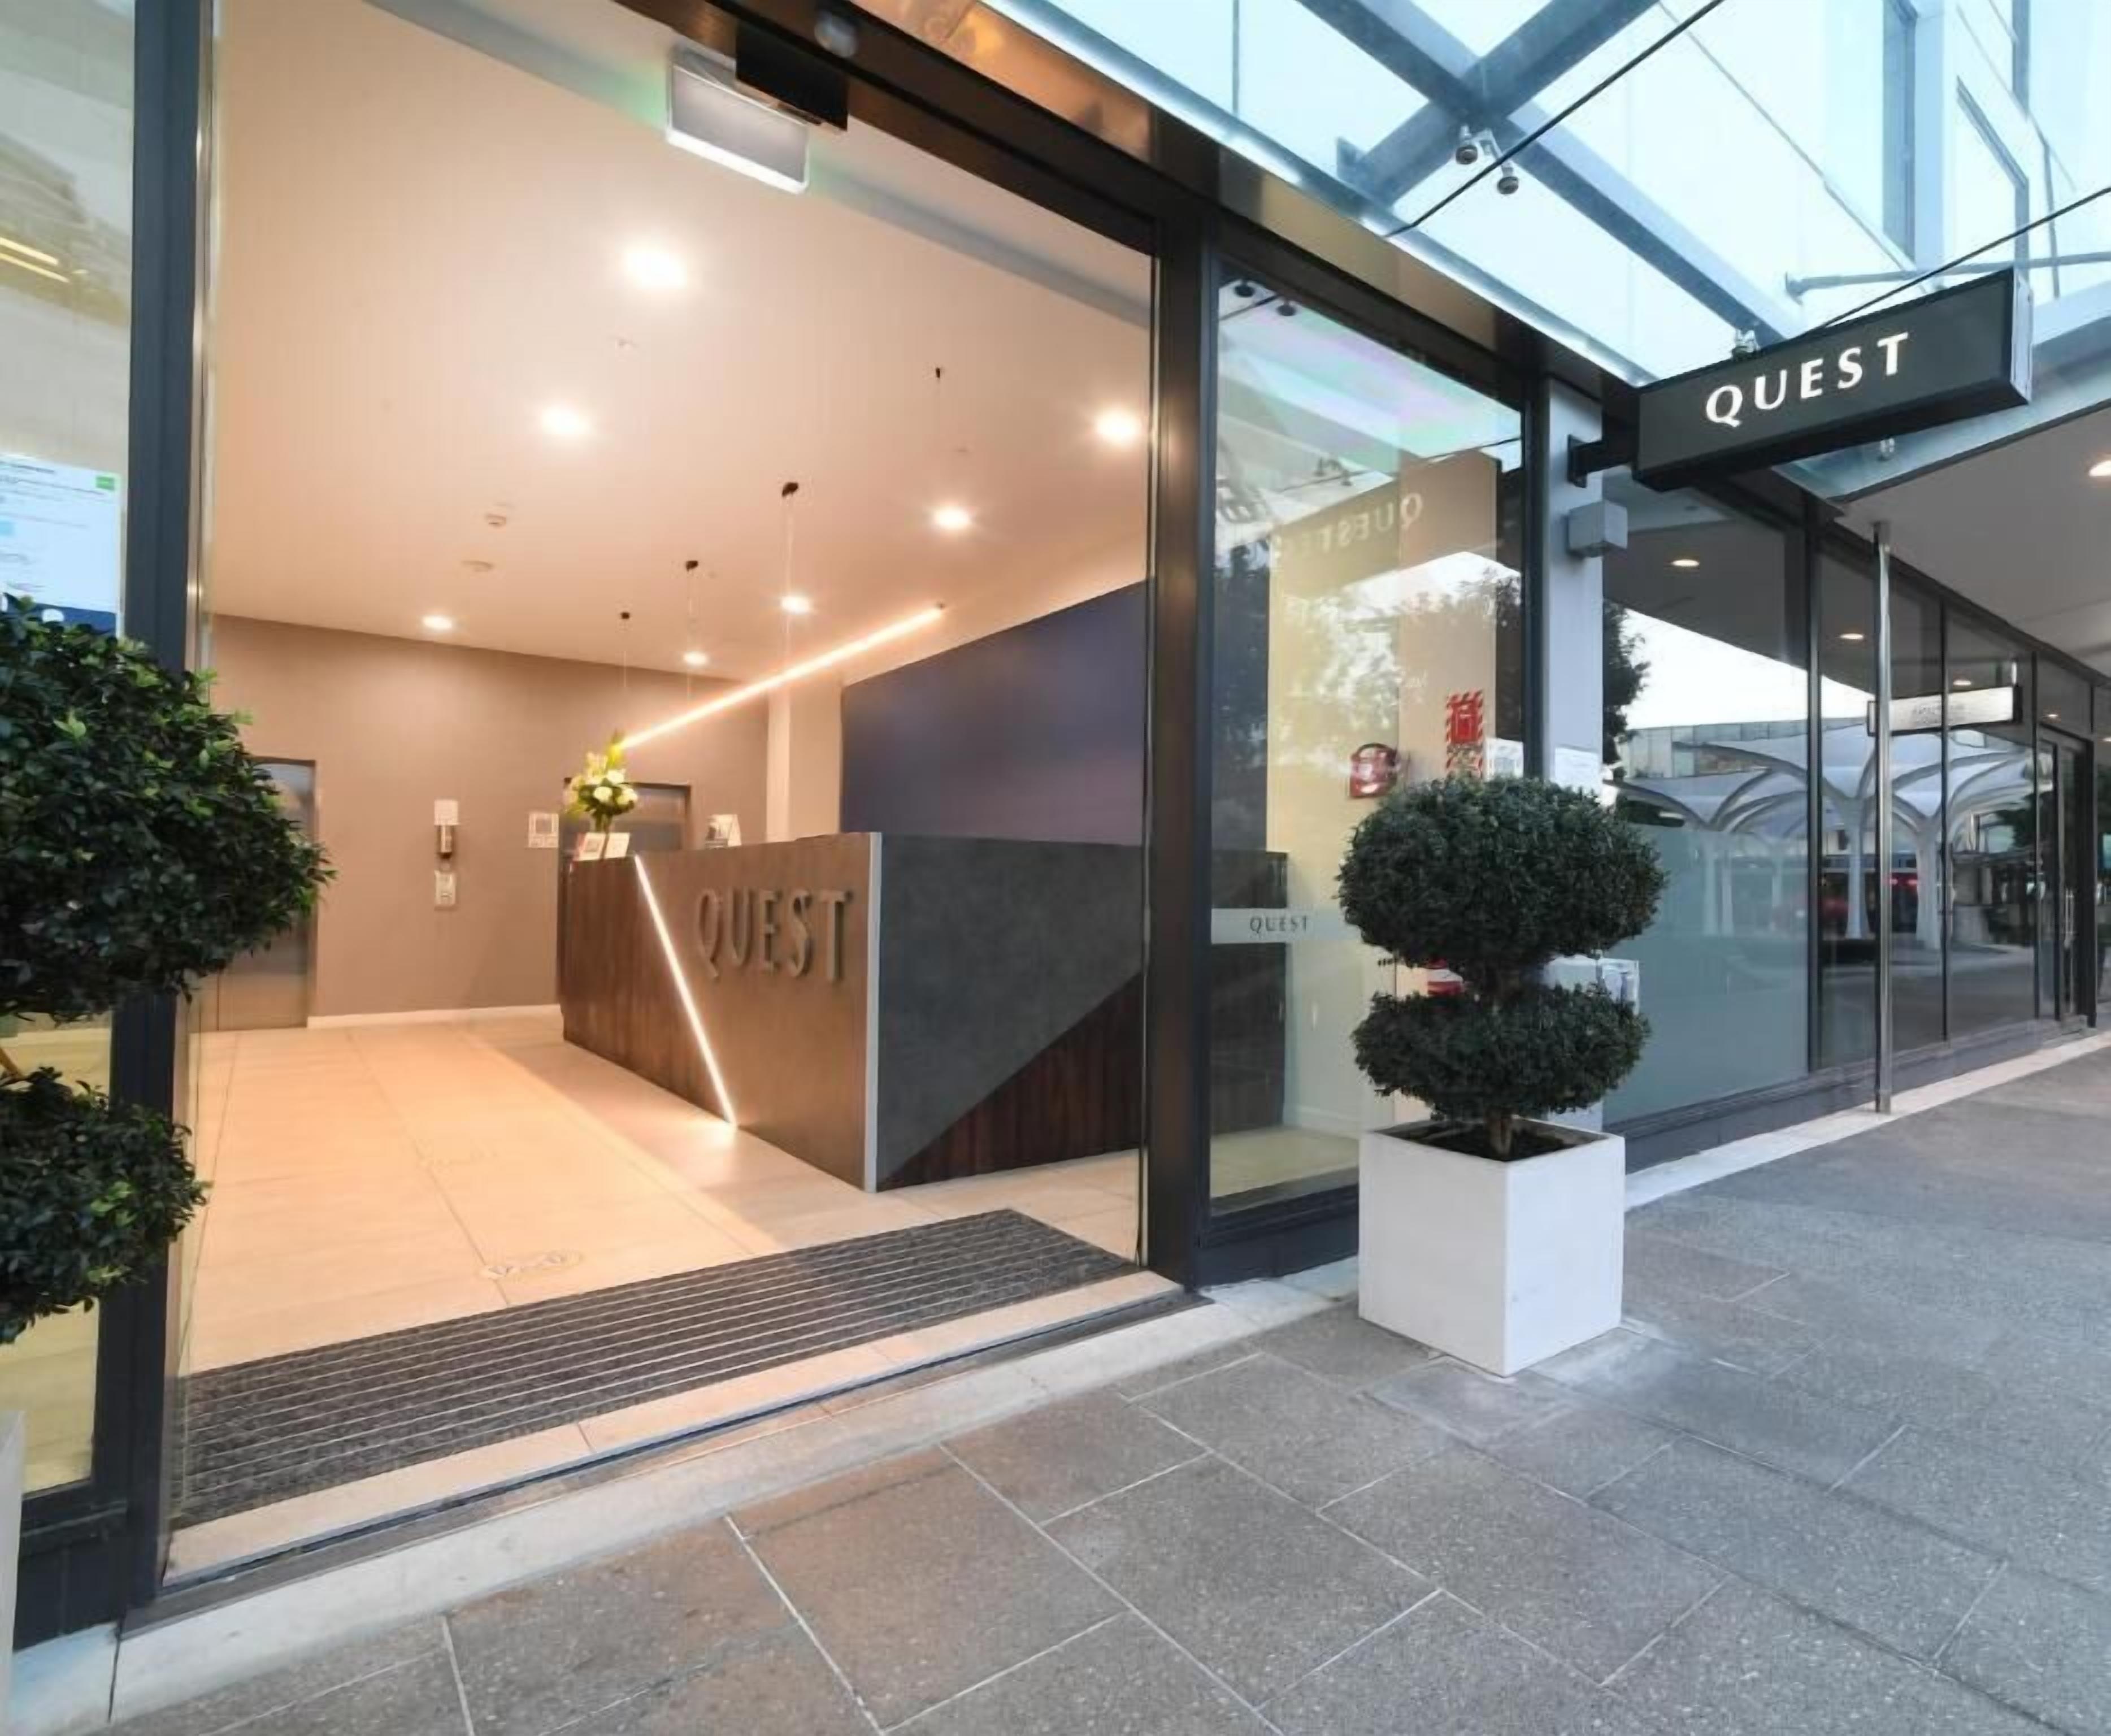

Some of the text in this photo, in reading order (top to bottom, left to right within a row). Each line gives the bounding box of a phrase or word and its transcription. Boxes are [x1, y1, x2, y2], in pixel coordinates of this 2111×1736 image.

[1706, 332, 1909, 428] QUEST
[696, 889, 852, 982] QUEST
[1250, 915, 1309, 933] QUEST
